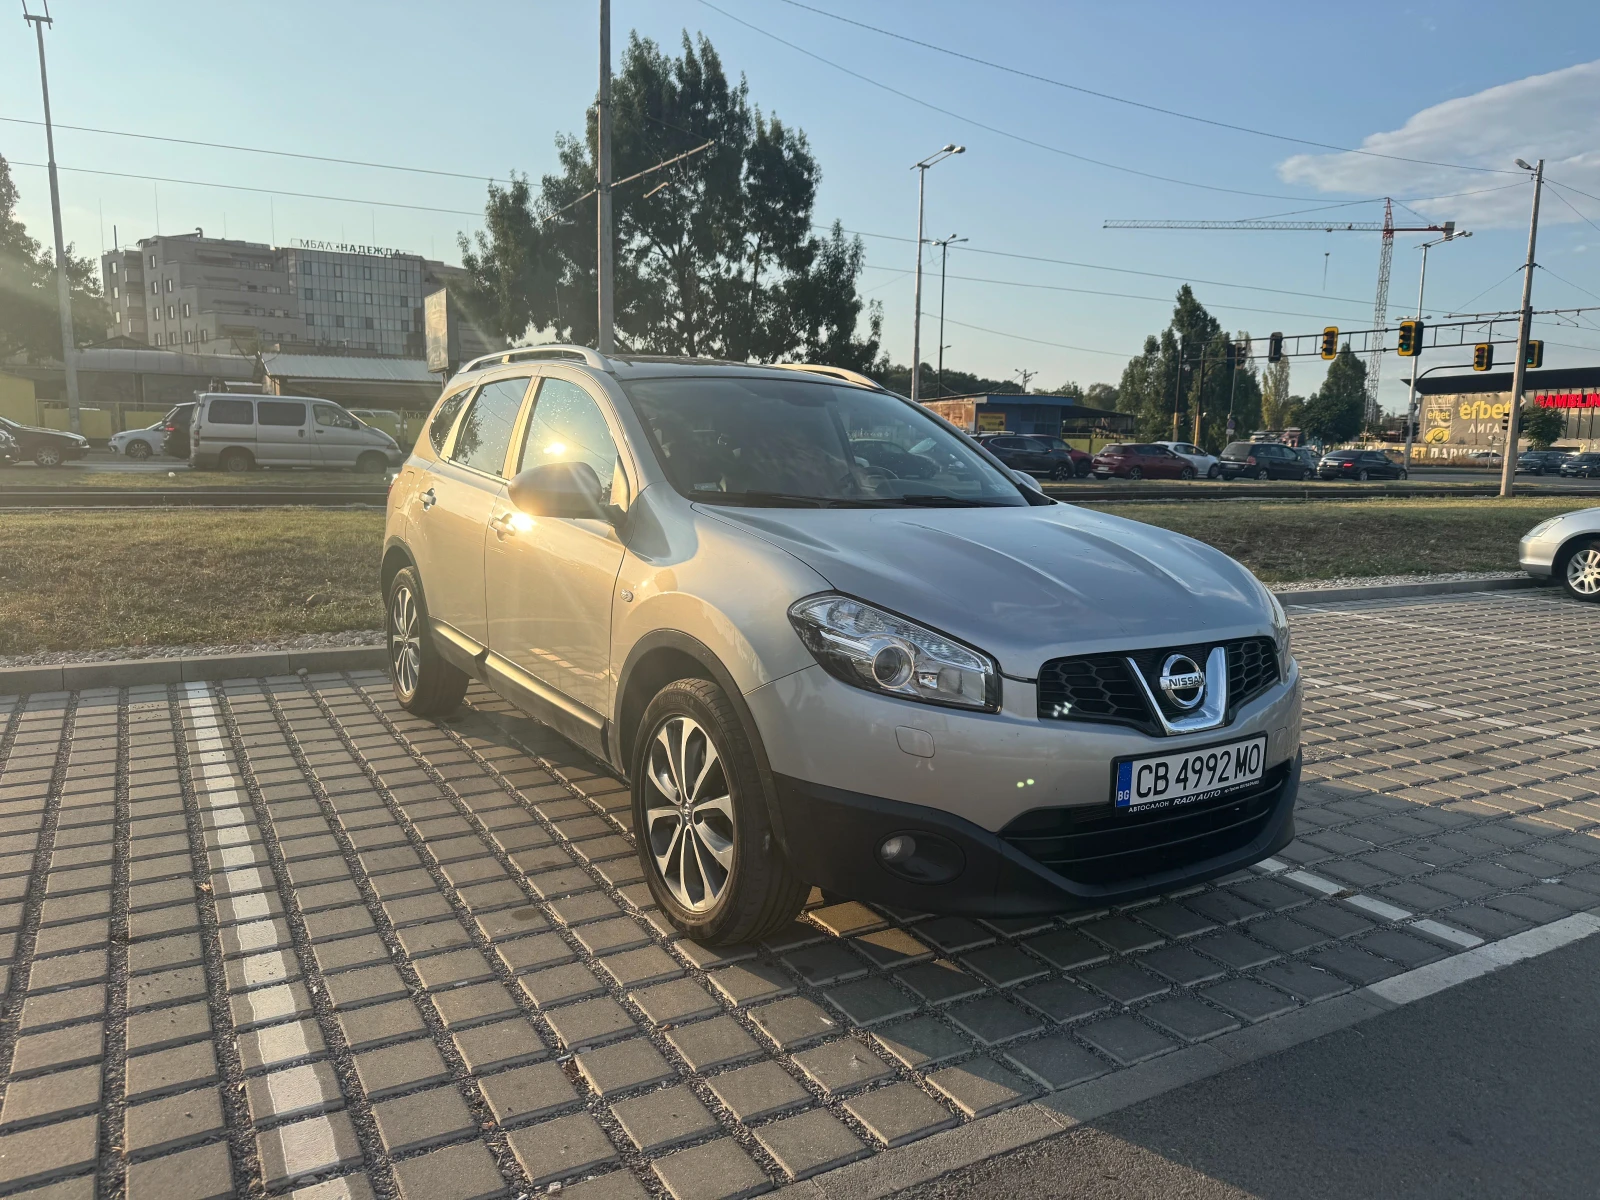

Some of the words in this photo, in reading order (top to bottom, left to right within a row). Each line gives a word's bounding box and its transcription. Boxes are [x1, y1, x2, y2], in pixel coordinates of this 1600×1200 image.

[299, 239, 333, 251] МБАЛ
[1468, 423, 1500, 433] ЛИГА
[1169, 674, 1203, 687] NISSAN
[1175, 750, 1232, 791] 4992
[1117, 790, 1130, 801] BG
[1172, 795, 1197, 806] RADI
[1197, 789, 1222, 801] AUTO
[1128, 800, 1170, 813] АВТОСАЛОН
